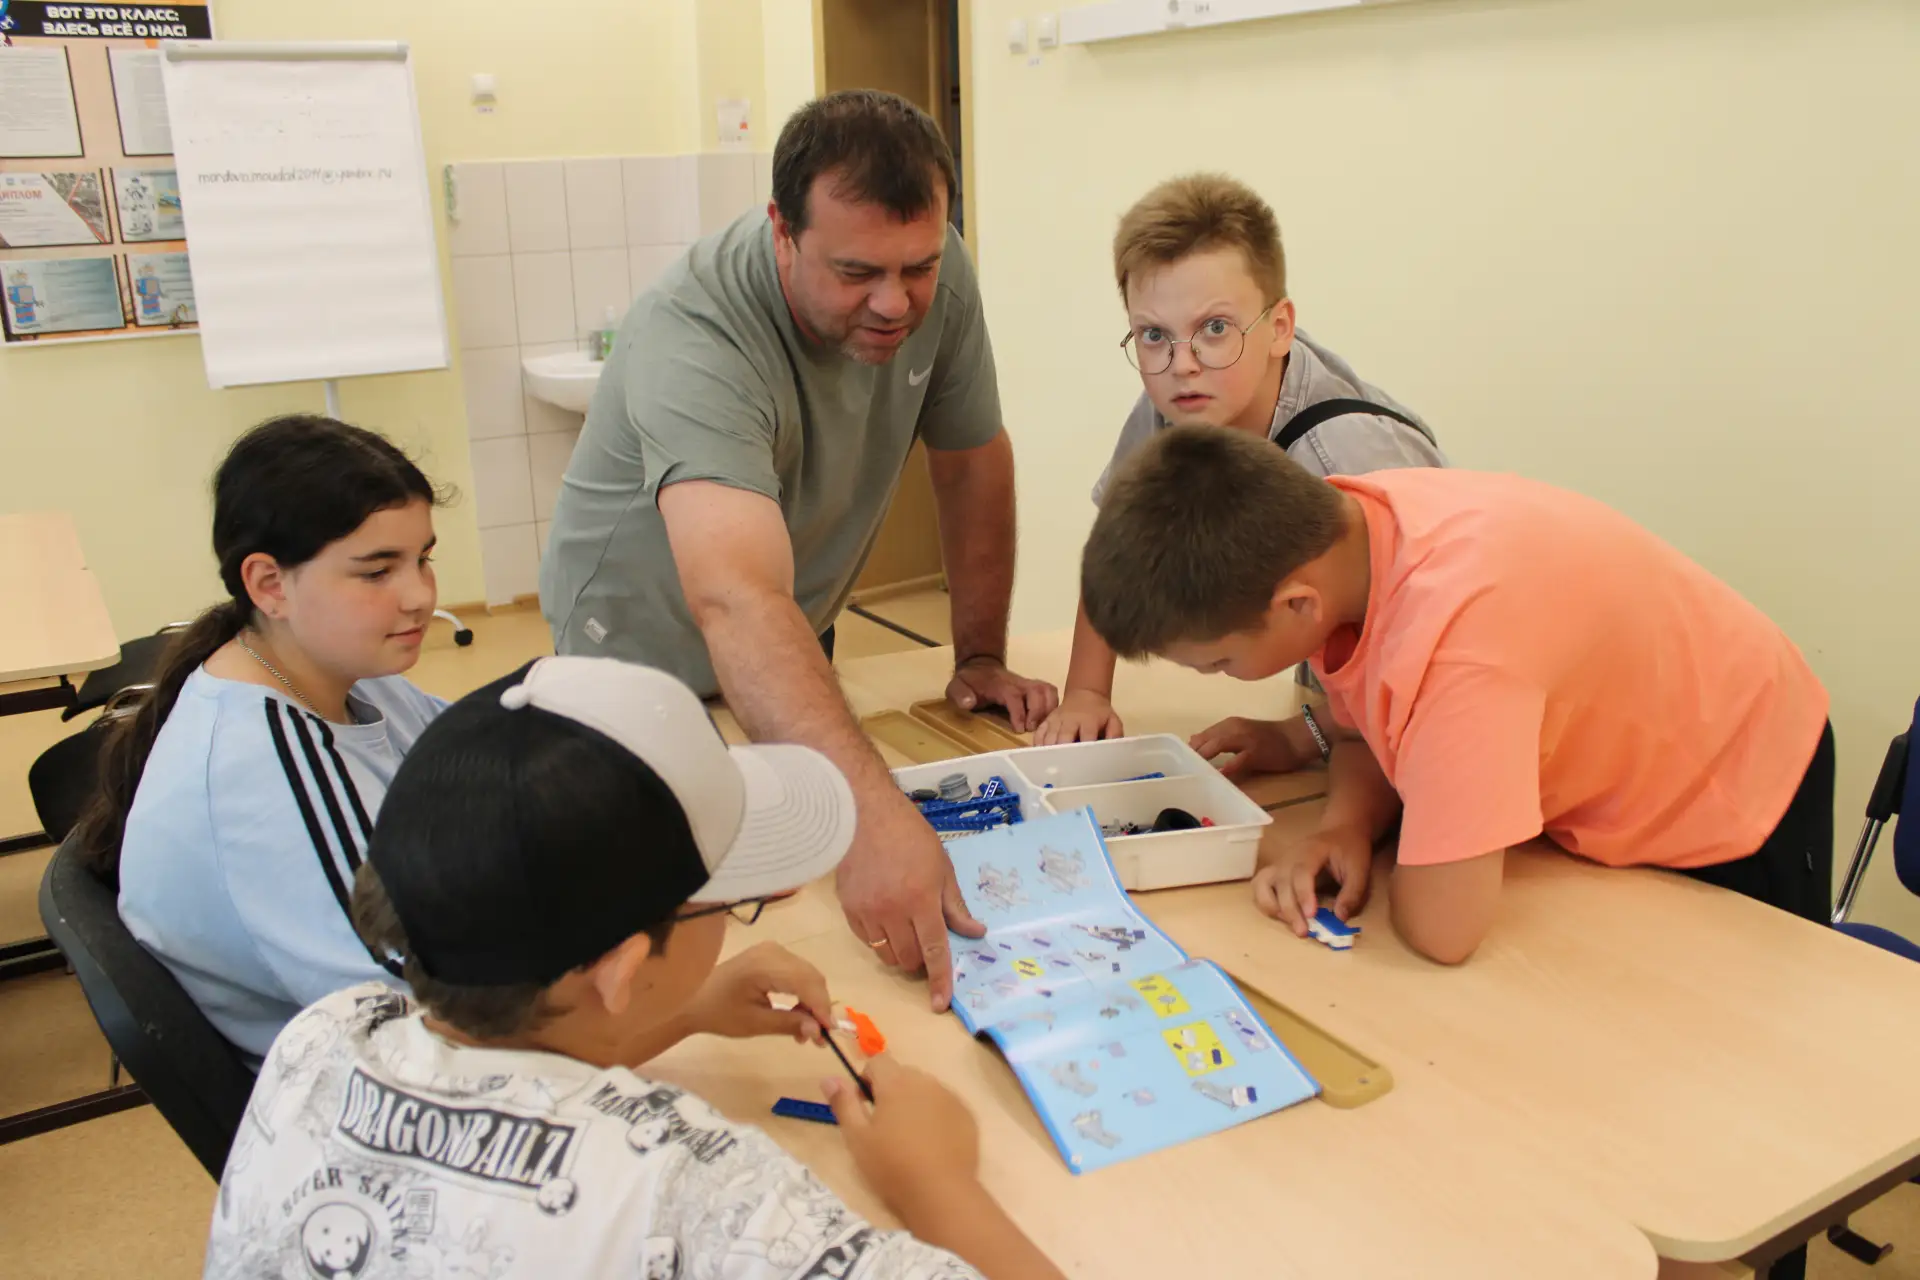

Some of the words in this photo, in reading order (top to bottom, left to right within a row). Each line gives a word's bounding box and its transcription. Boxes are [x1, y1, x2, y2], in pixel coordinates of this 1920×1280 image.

[46, 6, 82, 19] ВОТ
[84, 7, 118, 21] ЭТО
[120, 8, 179, 21] КЛАСС:
[42, 22, 99, 35] ЗДЕСЬ
[101, 22, 133, 36] ВСЁ
[135, 25, 148, 36] О
[150, 25, 187, 37] НАС!
